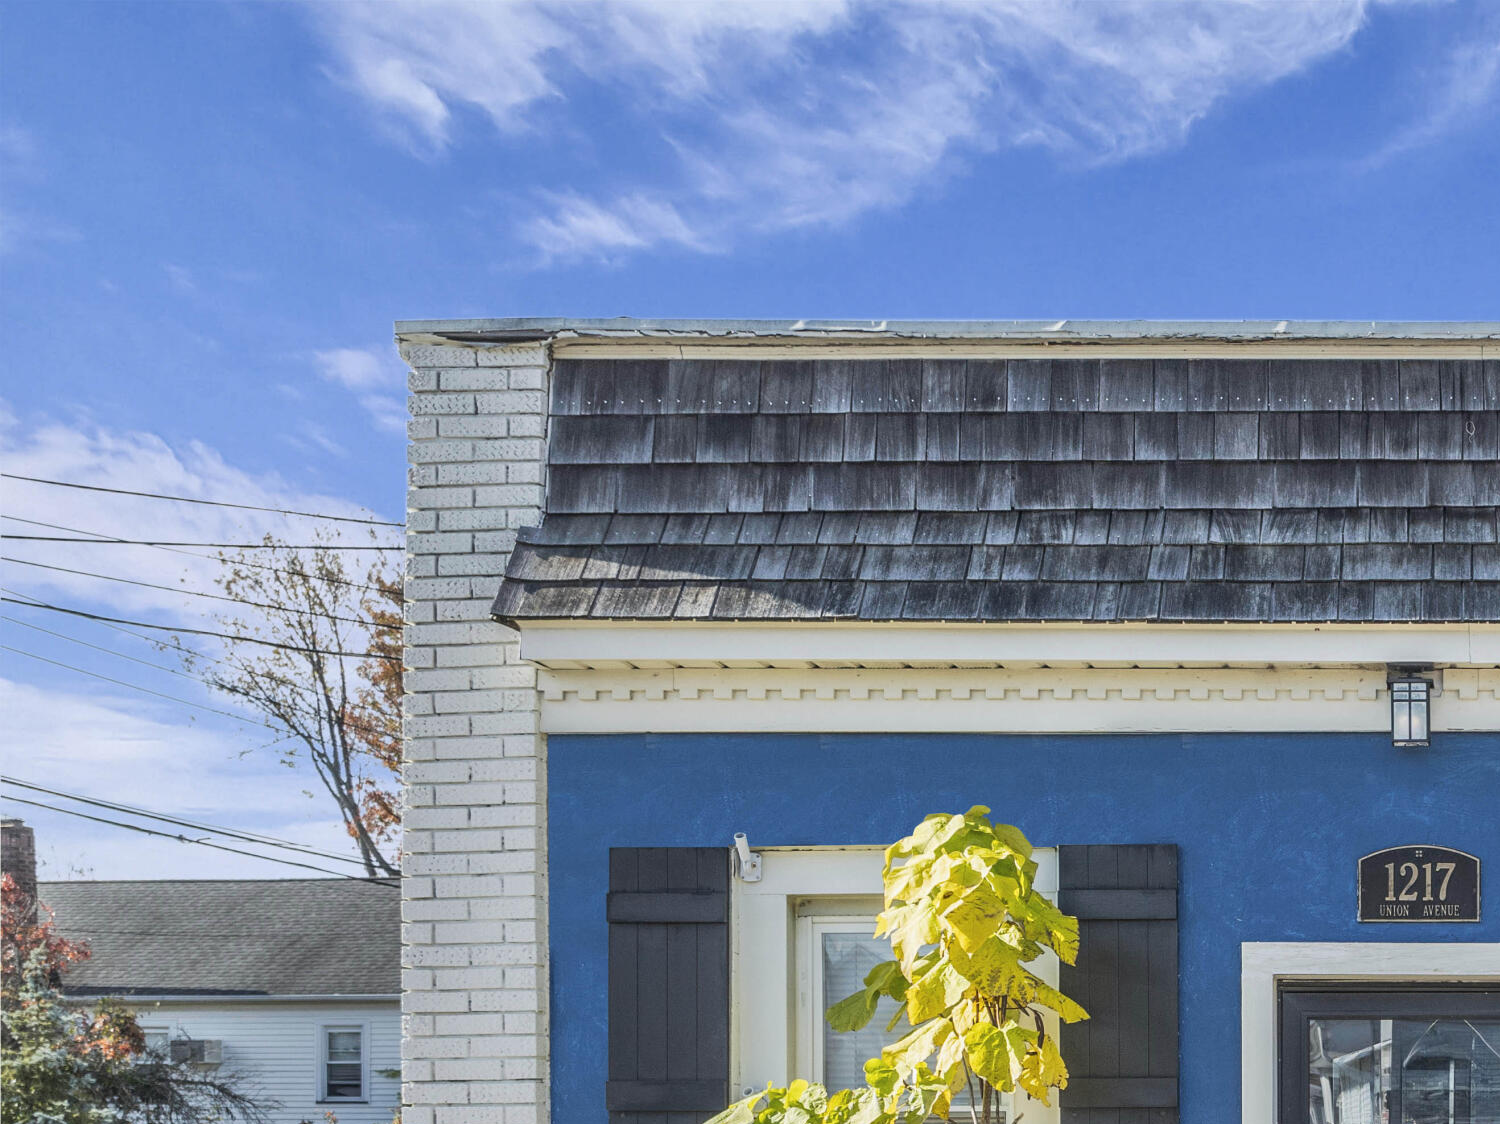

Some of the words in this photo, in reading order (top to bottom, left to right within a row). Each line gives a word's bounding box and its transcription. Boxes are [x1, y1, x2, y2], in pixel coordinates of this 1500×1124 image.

[1384, 862, 1456, 901] 1217
[1379, 904, 1410, 917] UNION
[1423, 904, 1460, 917] AVENUE
